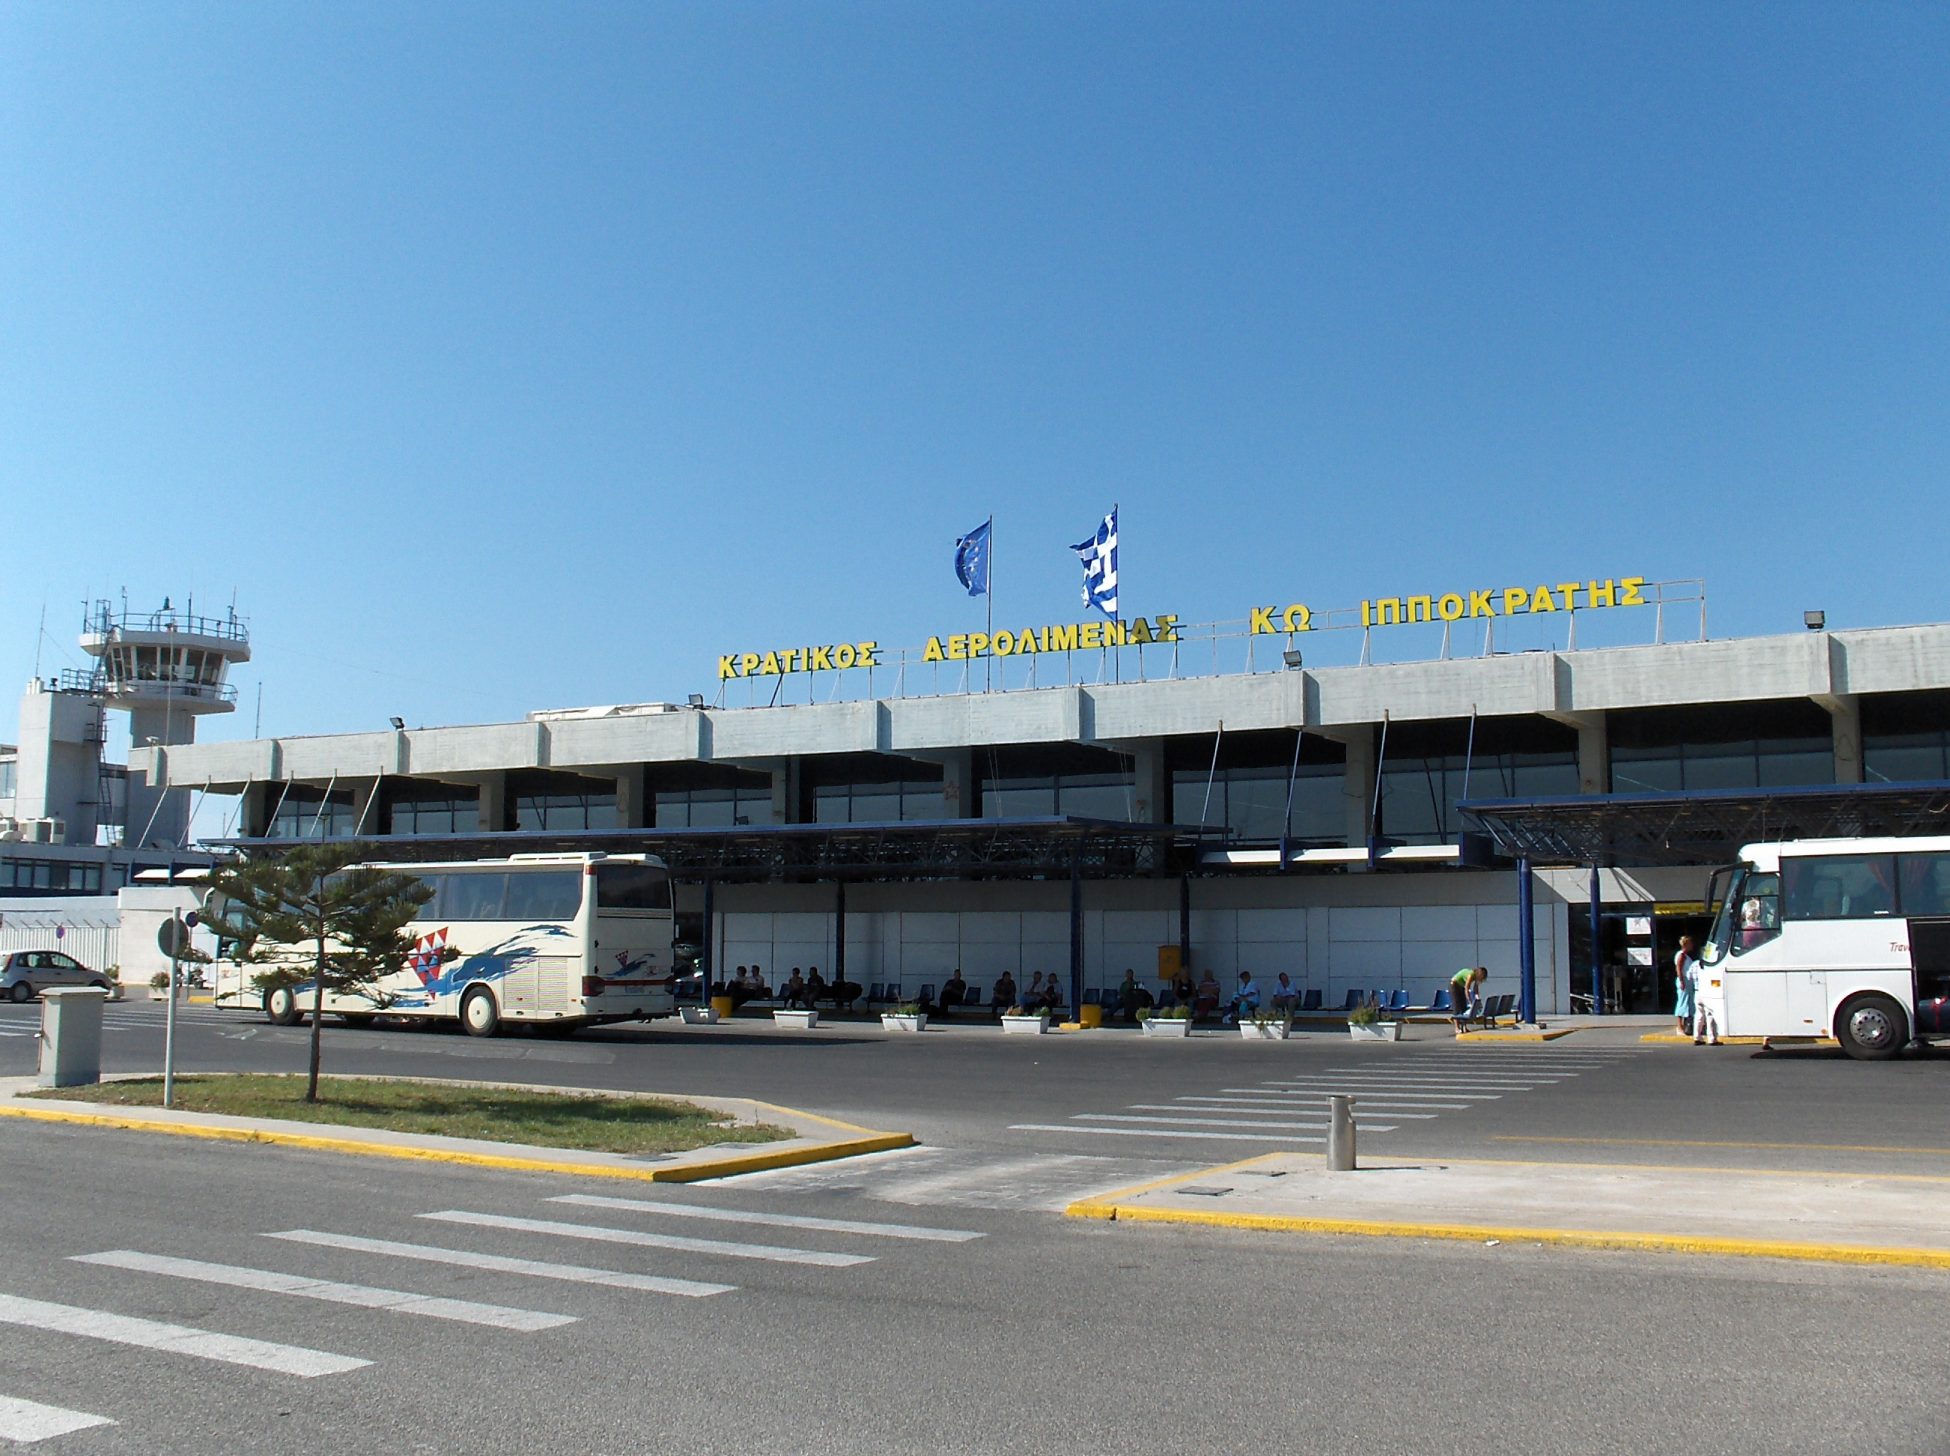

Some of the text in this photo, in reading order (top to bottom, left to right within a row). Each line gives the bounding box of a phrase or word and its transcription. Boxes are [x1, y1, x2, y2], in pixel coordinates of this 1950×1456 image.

[718, 576, 1646, 679] ΚΡΑΤΙΚΟΣ ΑΕΡΟΛΙΜΕΝΑΣ ΚΩ ΙΠΠΟΚΡΑΤΗΣ
